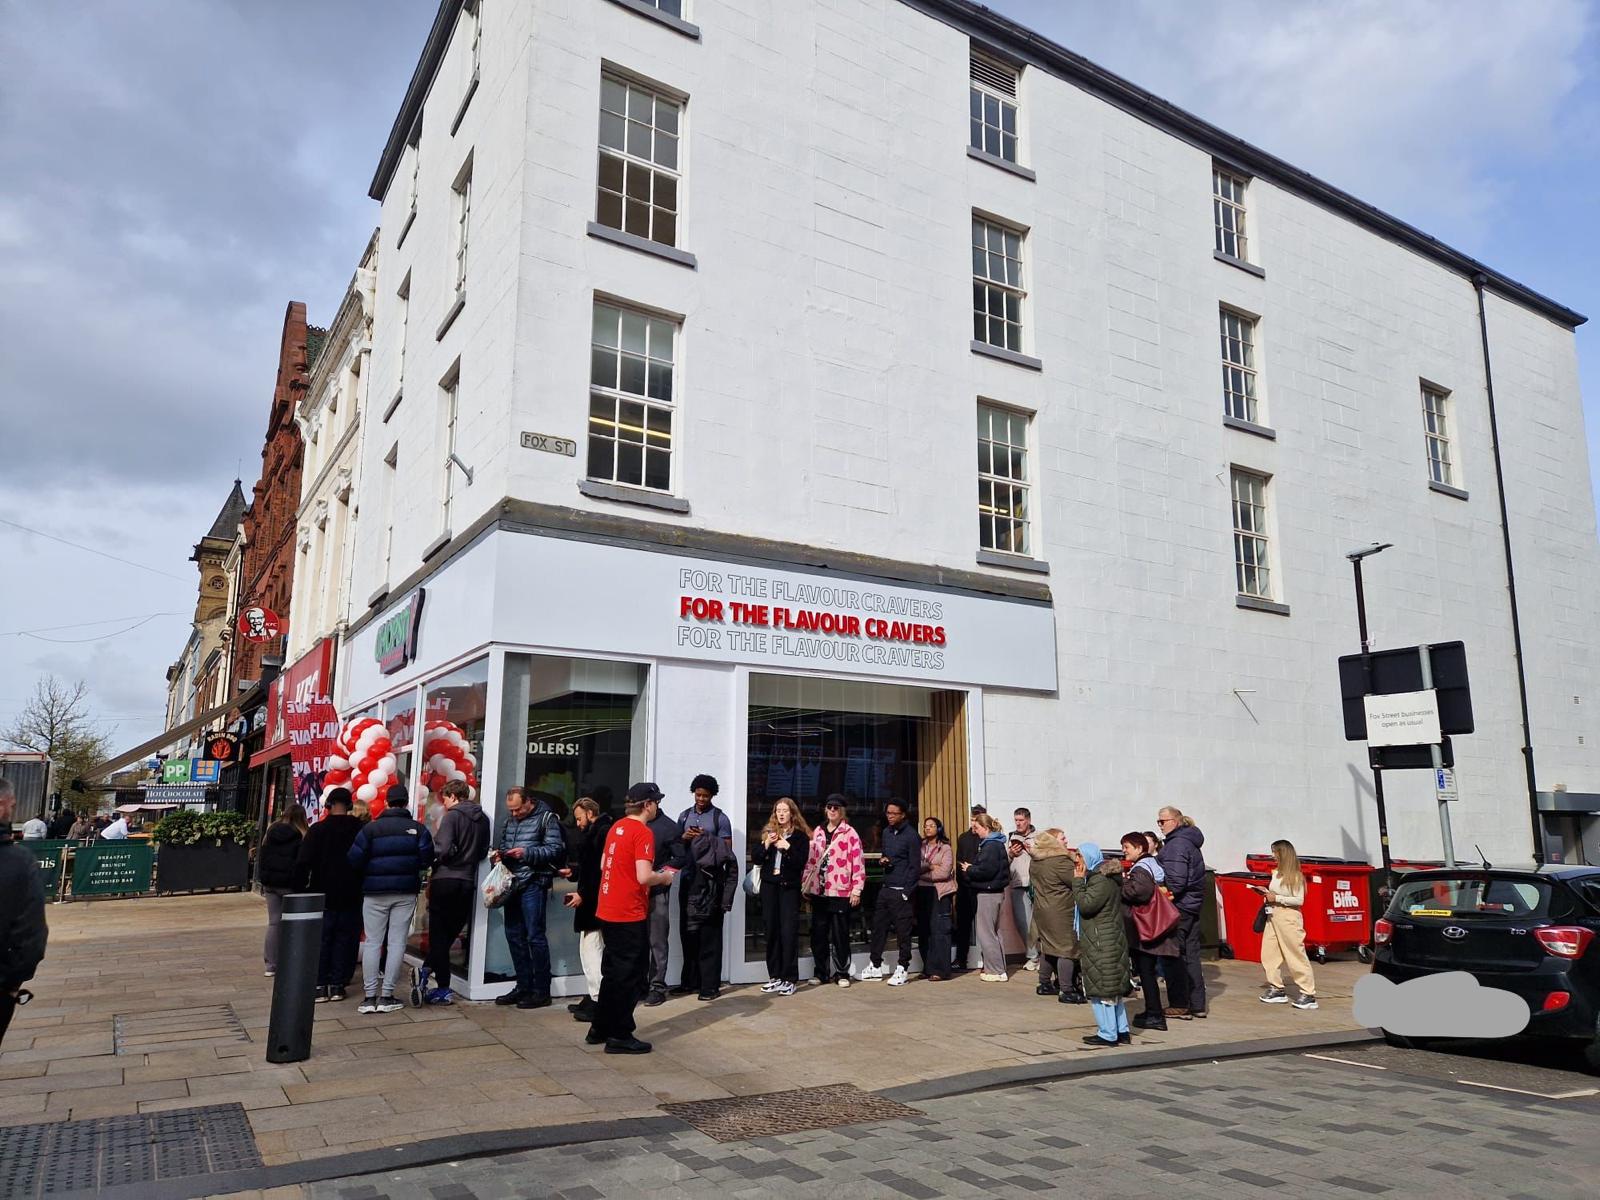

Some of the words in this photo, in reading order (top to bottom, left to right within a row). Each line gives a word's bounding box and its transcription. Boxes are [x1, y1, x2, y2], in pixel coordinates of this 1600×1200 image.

[525, 434, 548, 449] FOX
[679, 568, 723, 593] FOR
[727, 574, 768, 598] THE
[772, 580, 859, 609] FLAVOUR
[861, 592, 944, 621] CRAVERS
[680, 596, 723, 621] FOR
[729, 602, 769, 626] THE
[773, 607, 860, 636] FLAVOUR
[864, 618, 947, 646] CRAVERS
[677, 625, 722, 650] FOR
[727, 630, 767, 653] THE
[771, 635, 860, 662] FLAVOUR
[861, 643, 945, 670] CRAVERS
[527, 742, 579, 756] DLERS!
[147, 790, 162, 798] HOT
[163, 789, 203, 798] CHOCOLATE
[1333, 890, 1359, 908] Biffa
